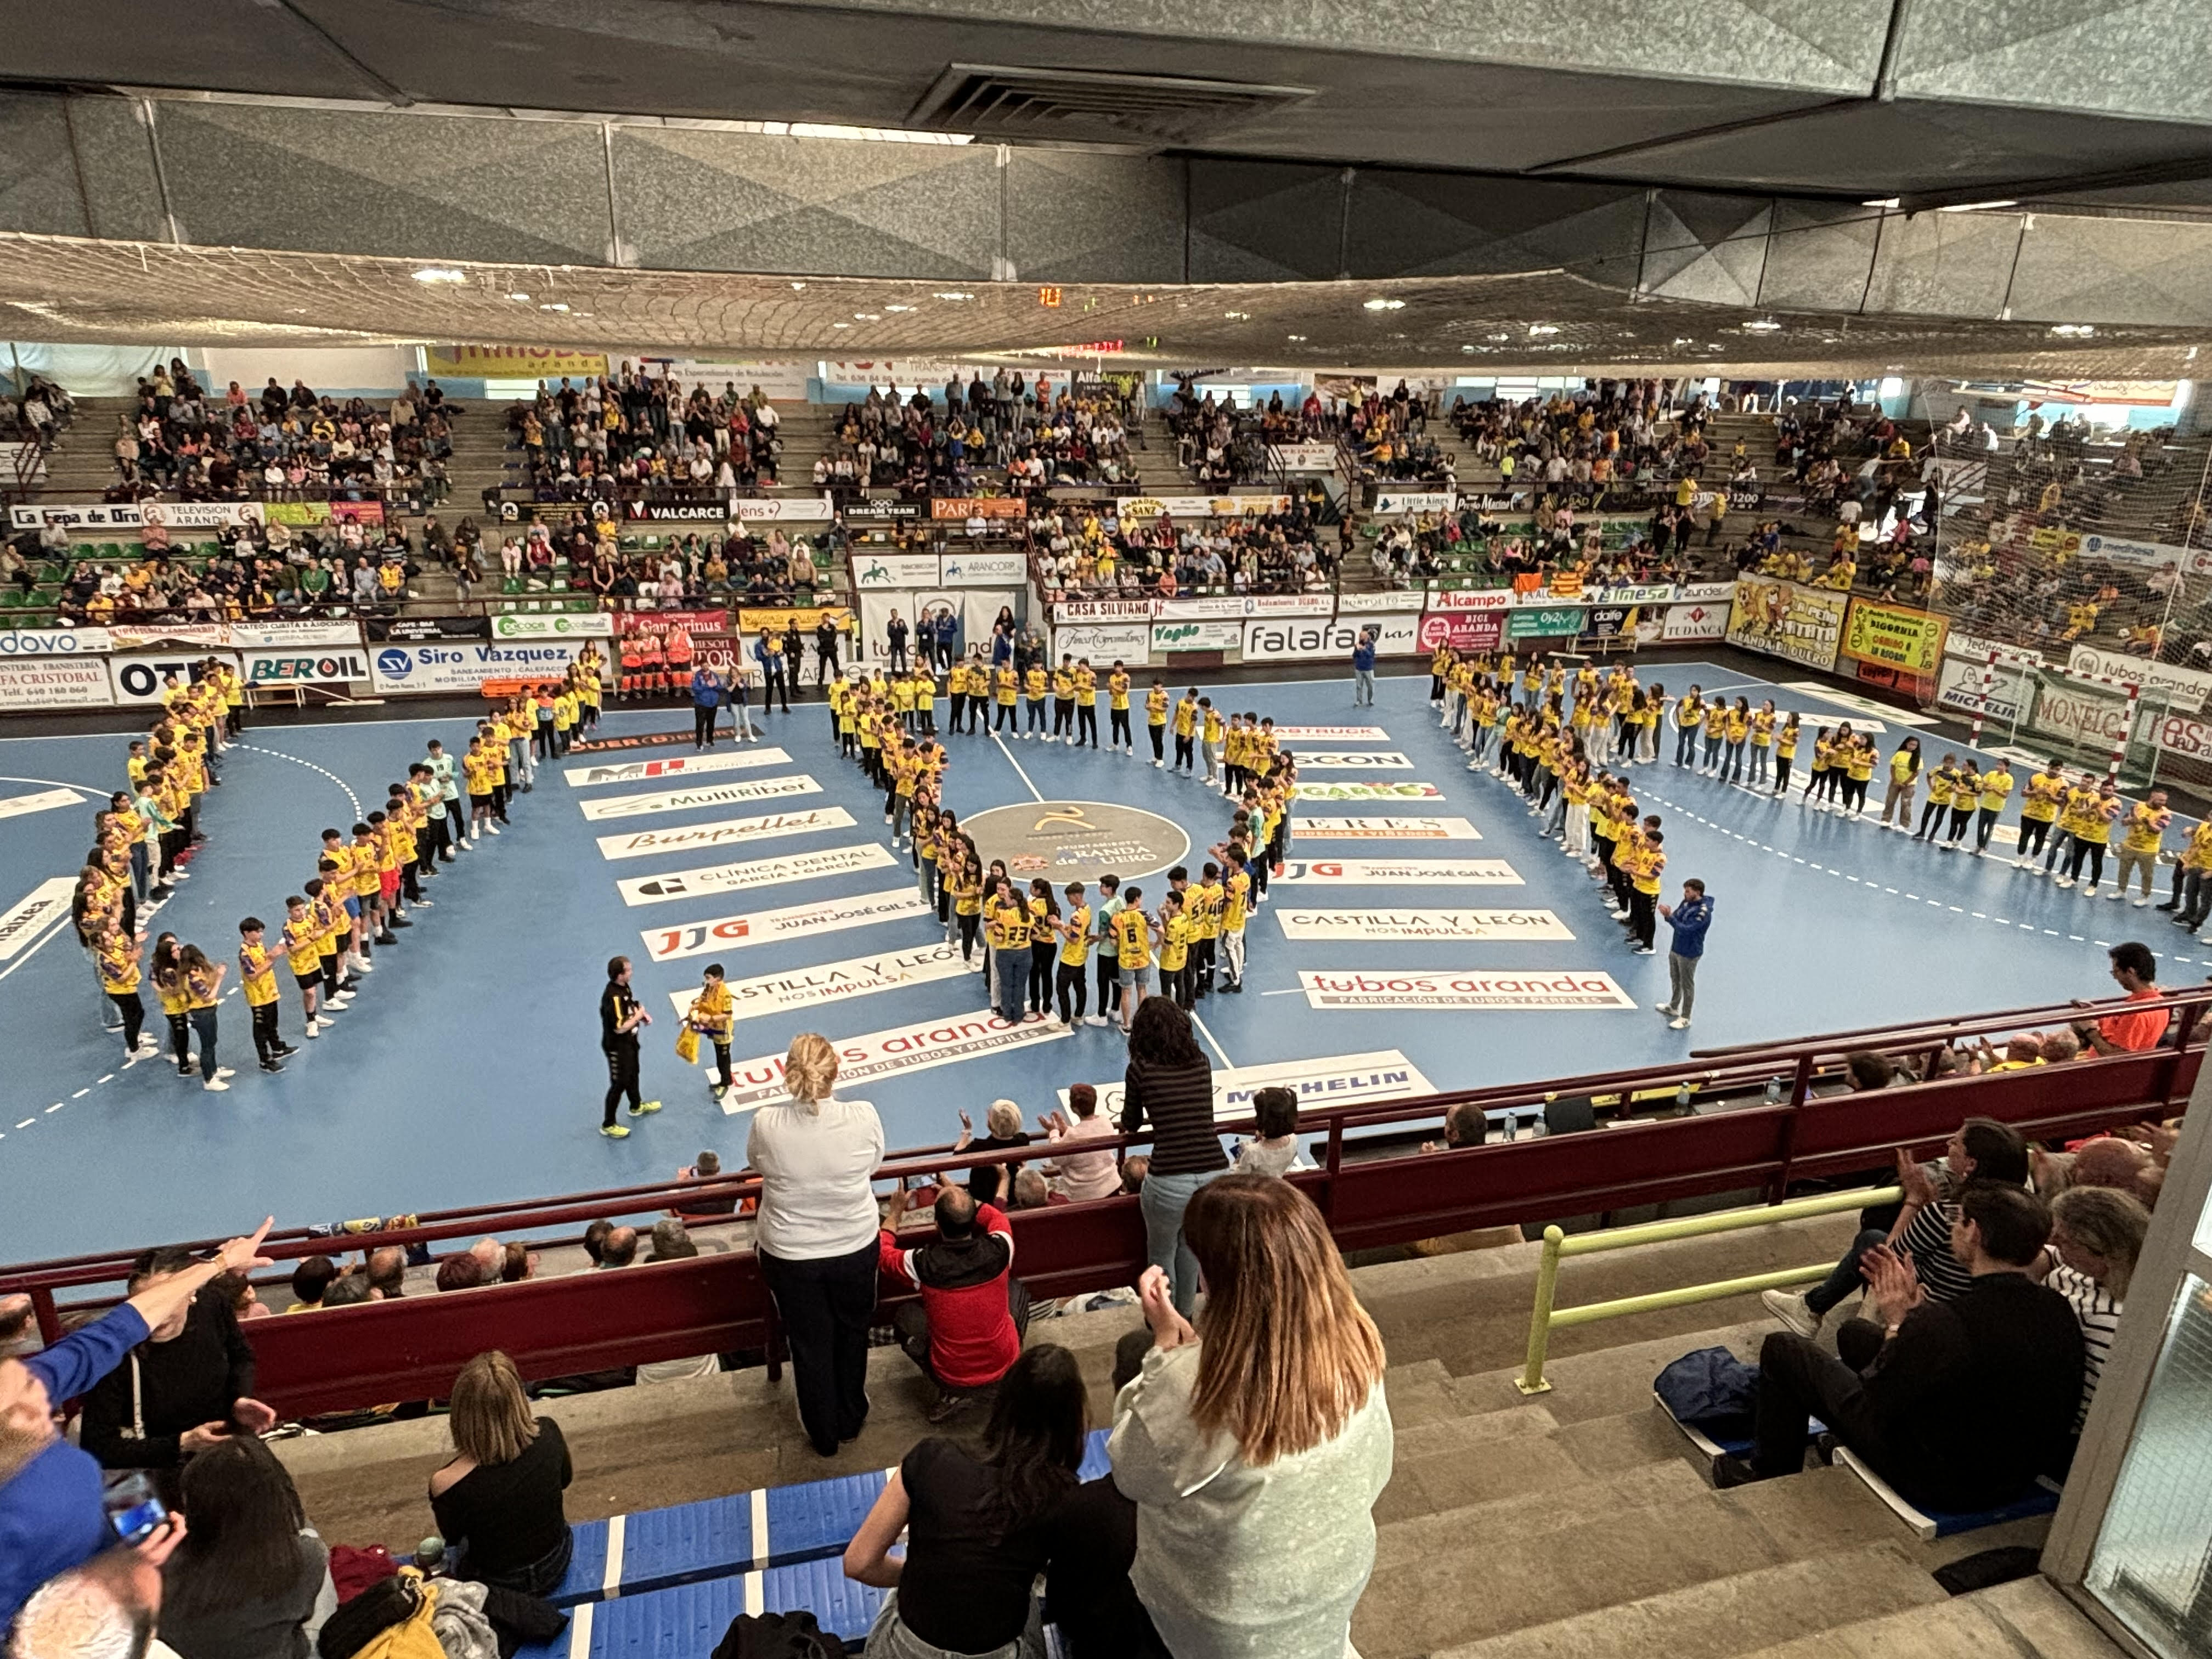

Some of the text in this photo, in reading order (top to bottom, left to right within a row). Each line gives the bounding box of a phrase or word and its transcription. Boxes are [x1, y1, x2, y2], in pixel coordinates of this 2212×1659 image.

[1732, 493, 1759, 503] 1200
[14, 510, 37, 524] La
[87, 509, 106, 523] de
[110, 508, 139, 522] Oro
[176, 516, 224, 525] ARAND
[651, 507, 724, 518] VALCARCE
[1436, 590, 1507, 608] Alcampo
[1684, 586, 1723, 598] zunder
[1067, 603, 1096, 616] CASA
[1101, 602, 1149, 615] SILVIANO
[0, 631, 77, 653] dovo
[417, 647, 464, 665] Siro
[250, 656, 366, 680] BEROIL
[21, 672, 103, 685] CRISTOBAL
[2103, 661, 2208, 697] tubos aranda
[627, 811, 820, 850] Burpellet
[1056, 840, 1141, 851] AYUNTAMIENTO
[699, 848, 876, 883] CLÍNICA DENTAL
[725, 871, 789, 887] GARCÍA
[802, 860, 862, 876] GARCÍA
[1272, 862, 1344, 880] JJG
[775, 915, 828, 930] JUAN
[830, 905, 877, 921] JOSÉ
[1291, 912, 1551, 927] CASTILLA Y LEÓN
[657, 919, 751, 955] JJG
[1009, 926, 1031, 943] 23
[862, 962, 884, 975] Y
[894, 945, 960, 969] LEÓ
[1312, 974, 1611, 994] tubos aranda
[1339, 995, 1444, 1005] FABRICACIÓN
[1445, 996, 1465, 1005] DE
[1465, 996, 1515, 1005] TUBOS
[1529, 996, 1603, 1005] PERFILES
[874, 1059, 896, 1073] DE
[896, 1047, 952, 1066] TUBOS
[966, 1027, 1040, 1052] PERFILES
[1226, 1070, 1409, 1104] MHELIN
